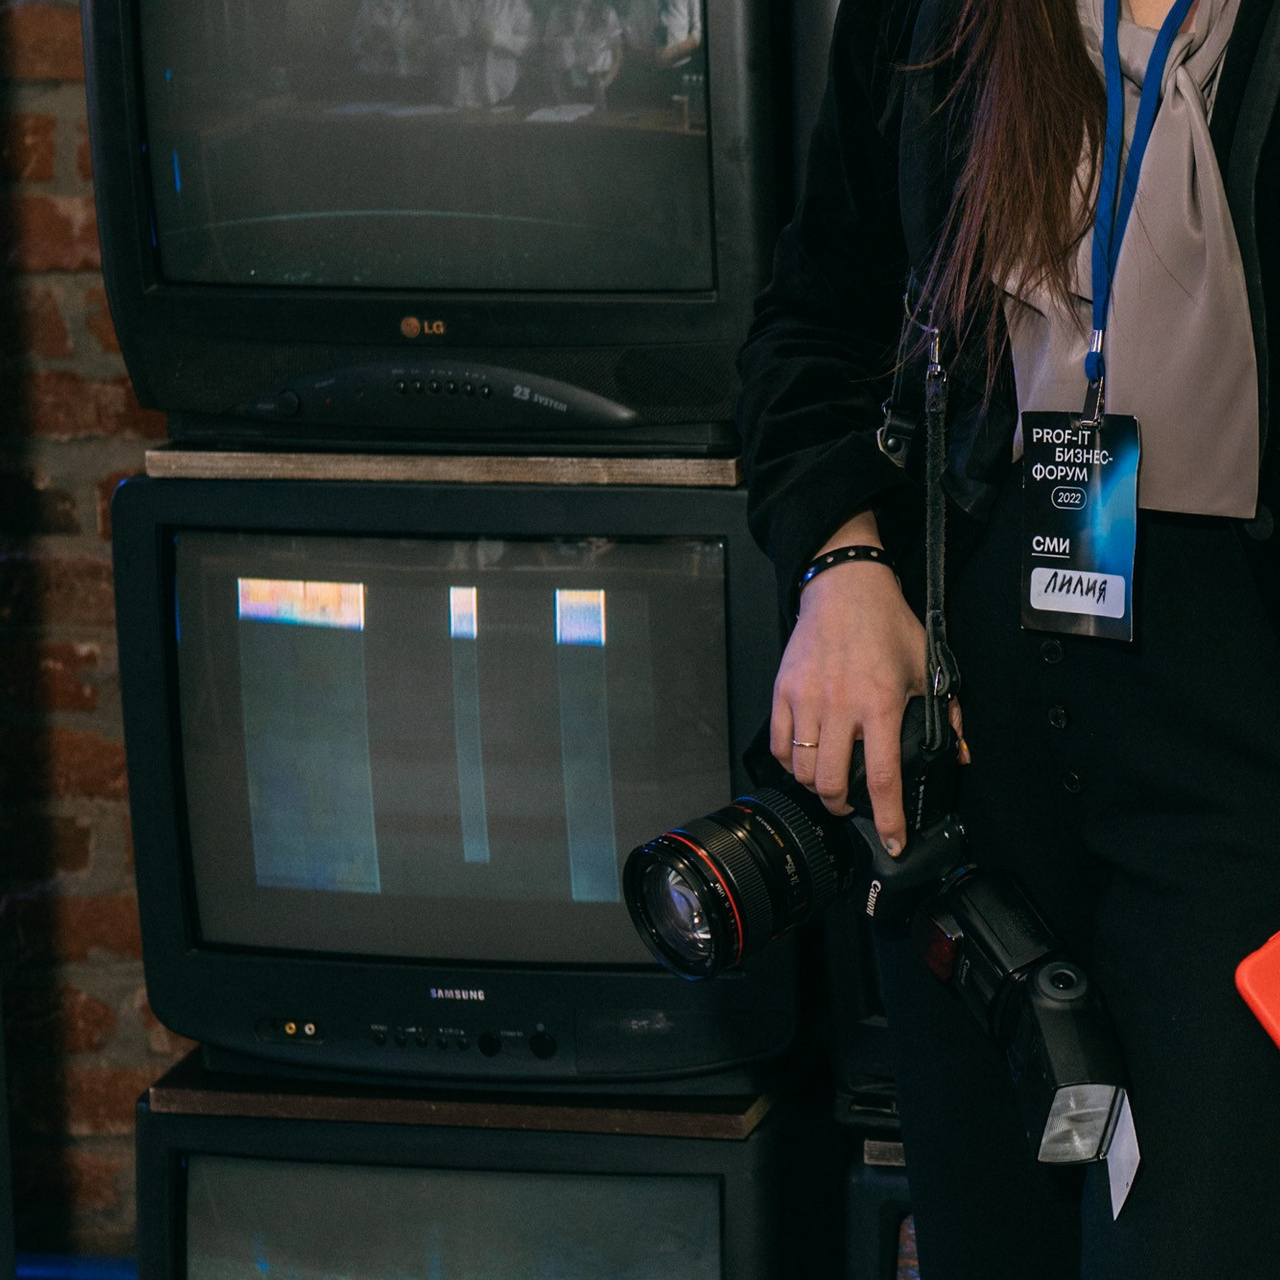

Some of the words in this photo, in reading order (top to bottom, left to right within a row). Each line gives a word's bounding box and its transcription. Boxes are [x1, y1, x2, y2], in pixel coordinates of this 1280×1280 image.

[423, 320, 445, 335] LG
[512, 384, 532, 401] 23
[1032, 428, 1091, 445] PROF-IT
[1055, 448, 1113, 465] БИЗНЕС-
[1032, 463, 1088, 482] ФОРУМ
[1057, 492, 1081, 504] 2022
[1032, 535, 1070, 554] СМИ
[1044, 570, 1108, 604] ЛИЛИЯ
[866, 879, 882, 917] Canon
[430, 987, 486, 1001] SAMSUNG
